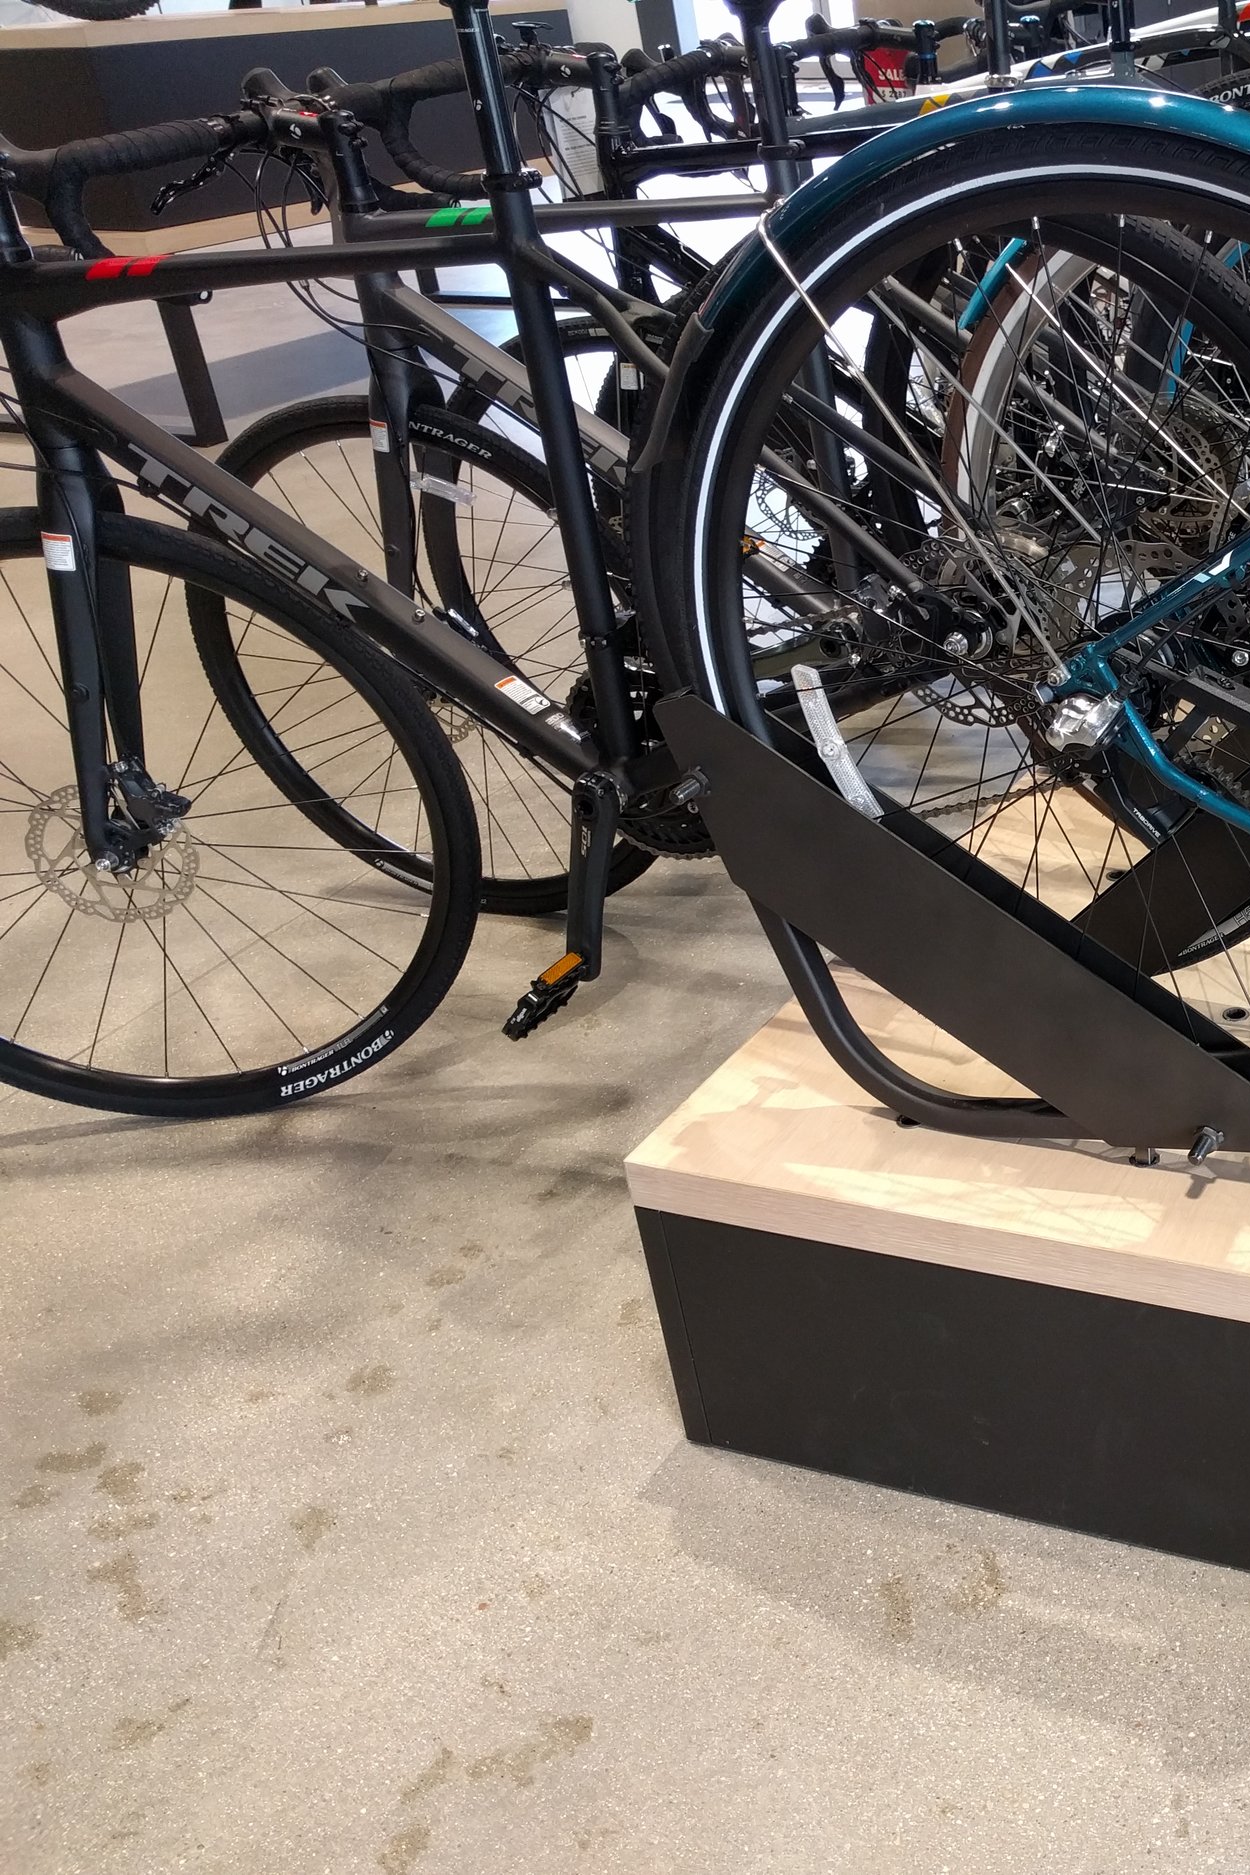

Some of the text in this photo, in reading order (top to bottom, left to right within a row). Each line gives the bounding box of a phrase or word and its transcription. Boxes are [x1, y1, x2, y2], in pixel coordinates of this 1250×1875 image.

[878, 68, 907, 81] SALE
[408, 420, 493, 460] NTRAGER
[127, 442, 371, 624] TREK
[279, 1034, 388, 1097] BONTRAGER
